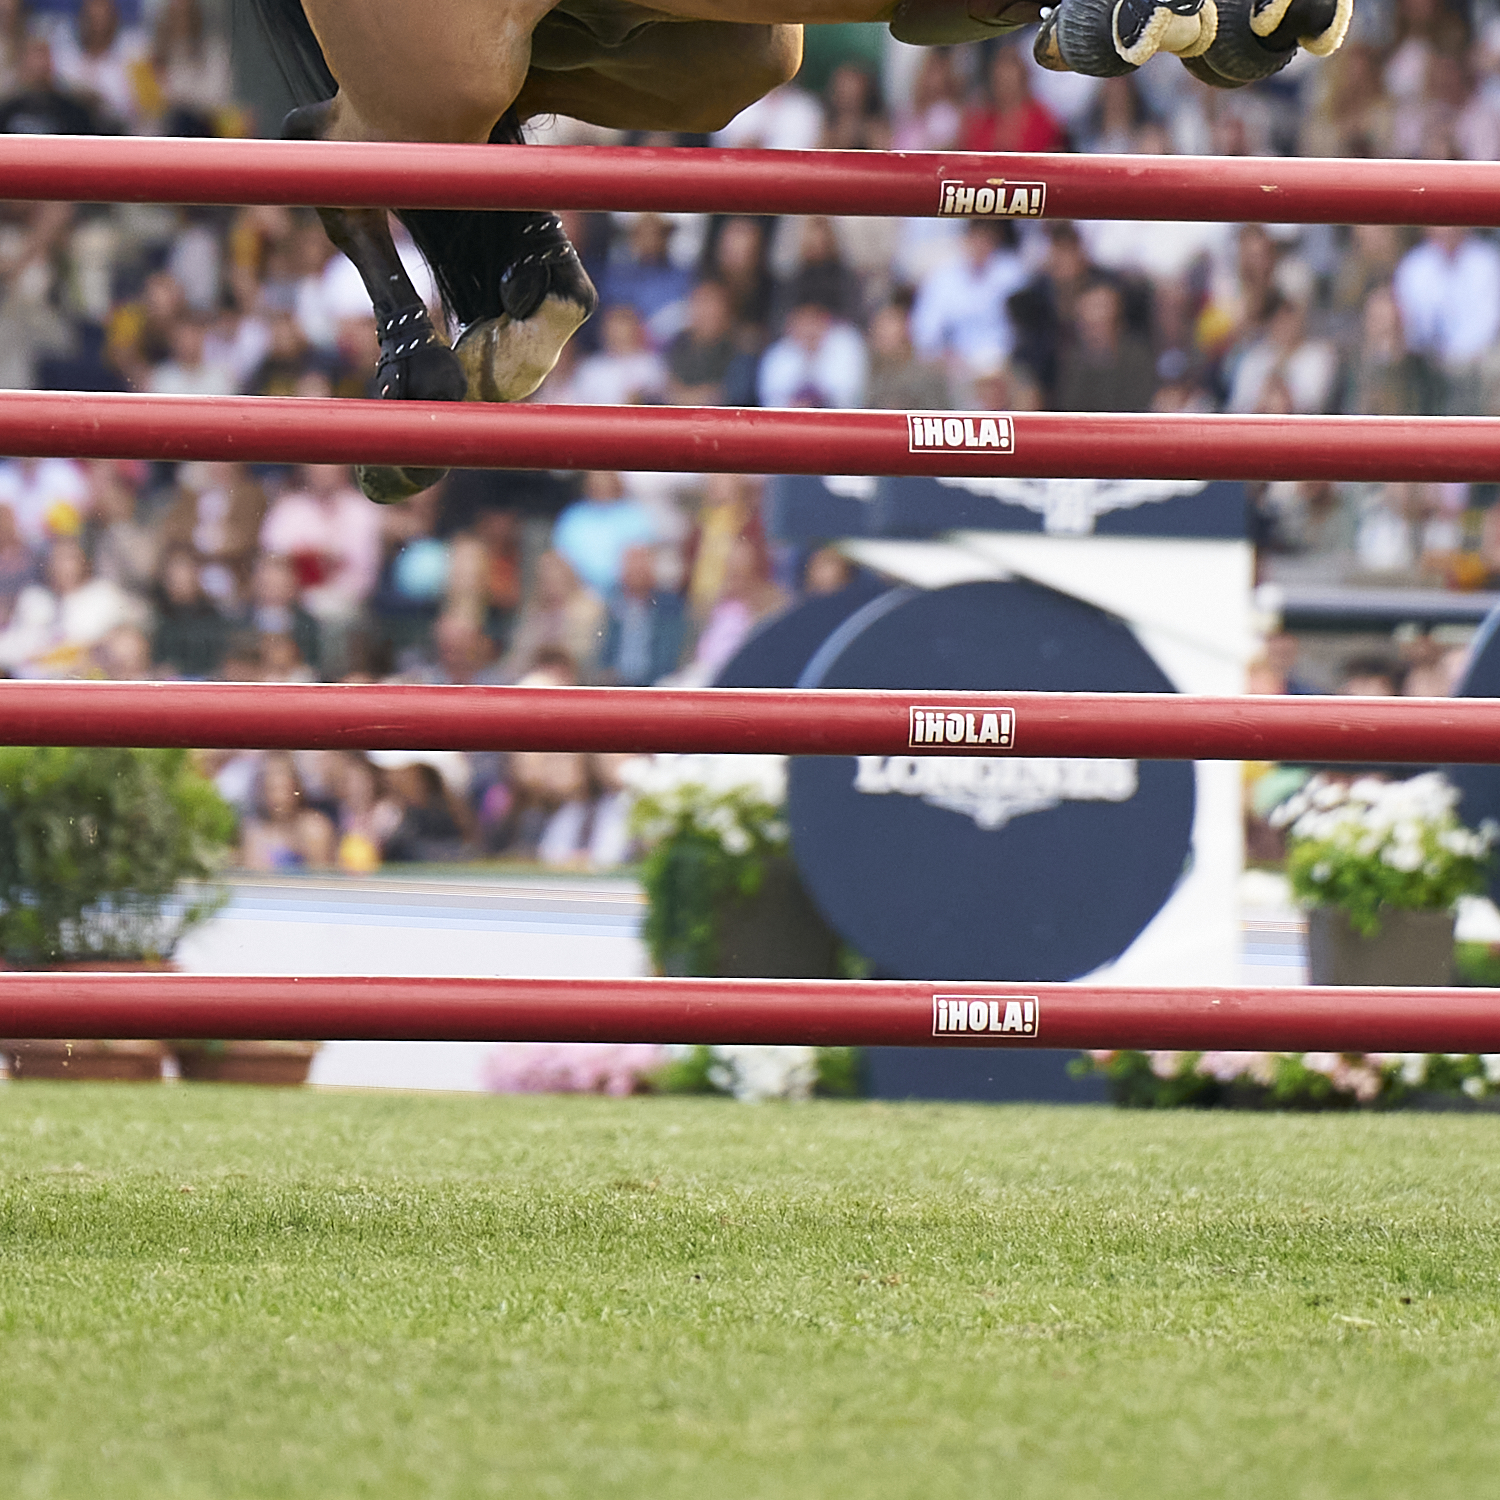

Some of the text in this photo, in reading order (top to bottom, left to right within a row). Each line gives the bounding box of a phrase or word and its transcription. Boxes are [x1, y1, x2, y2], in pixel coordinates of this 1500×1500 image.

[944, 185, 1041, 215] ¡HOLA!
[912, 417, 1010, 448] ¡HOLA!
[914, 710, 1010, 744] ¡HOLA!
[938, 998, 1034, 1033] ¡HOLA!
